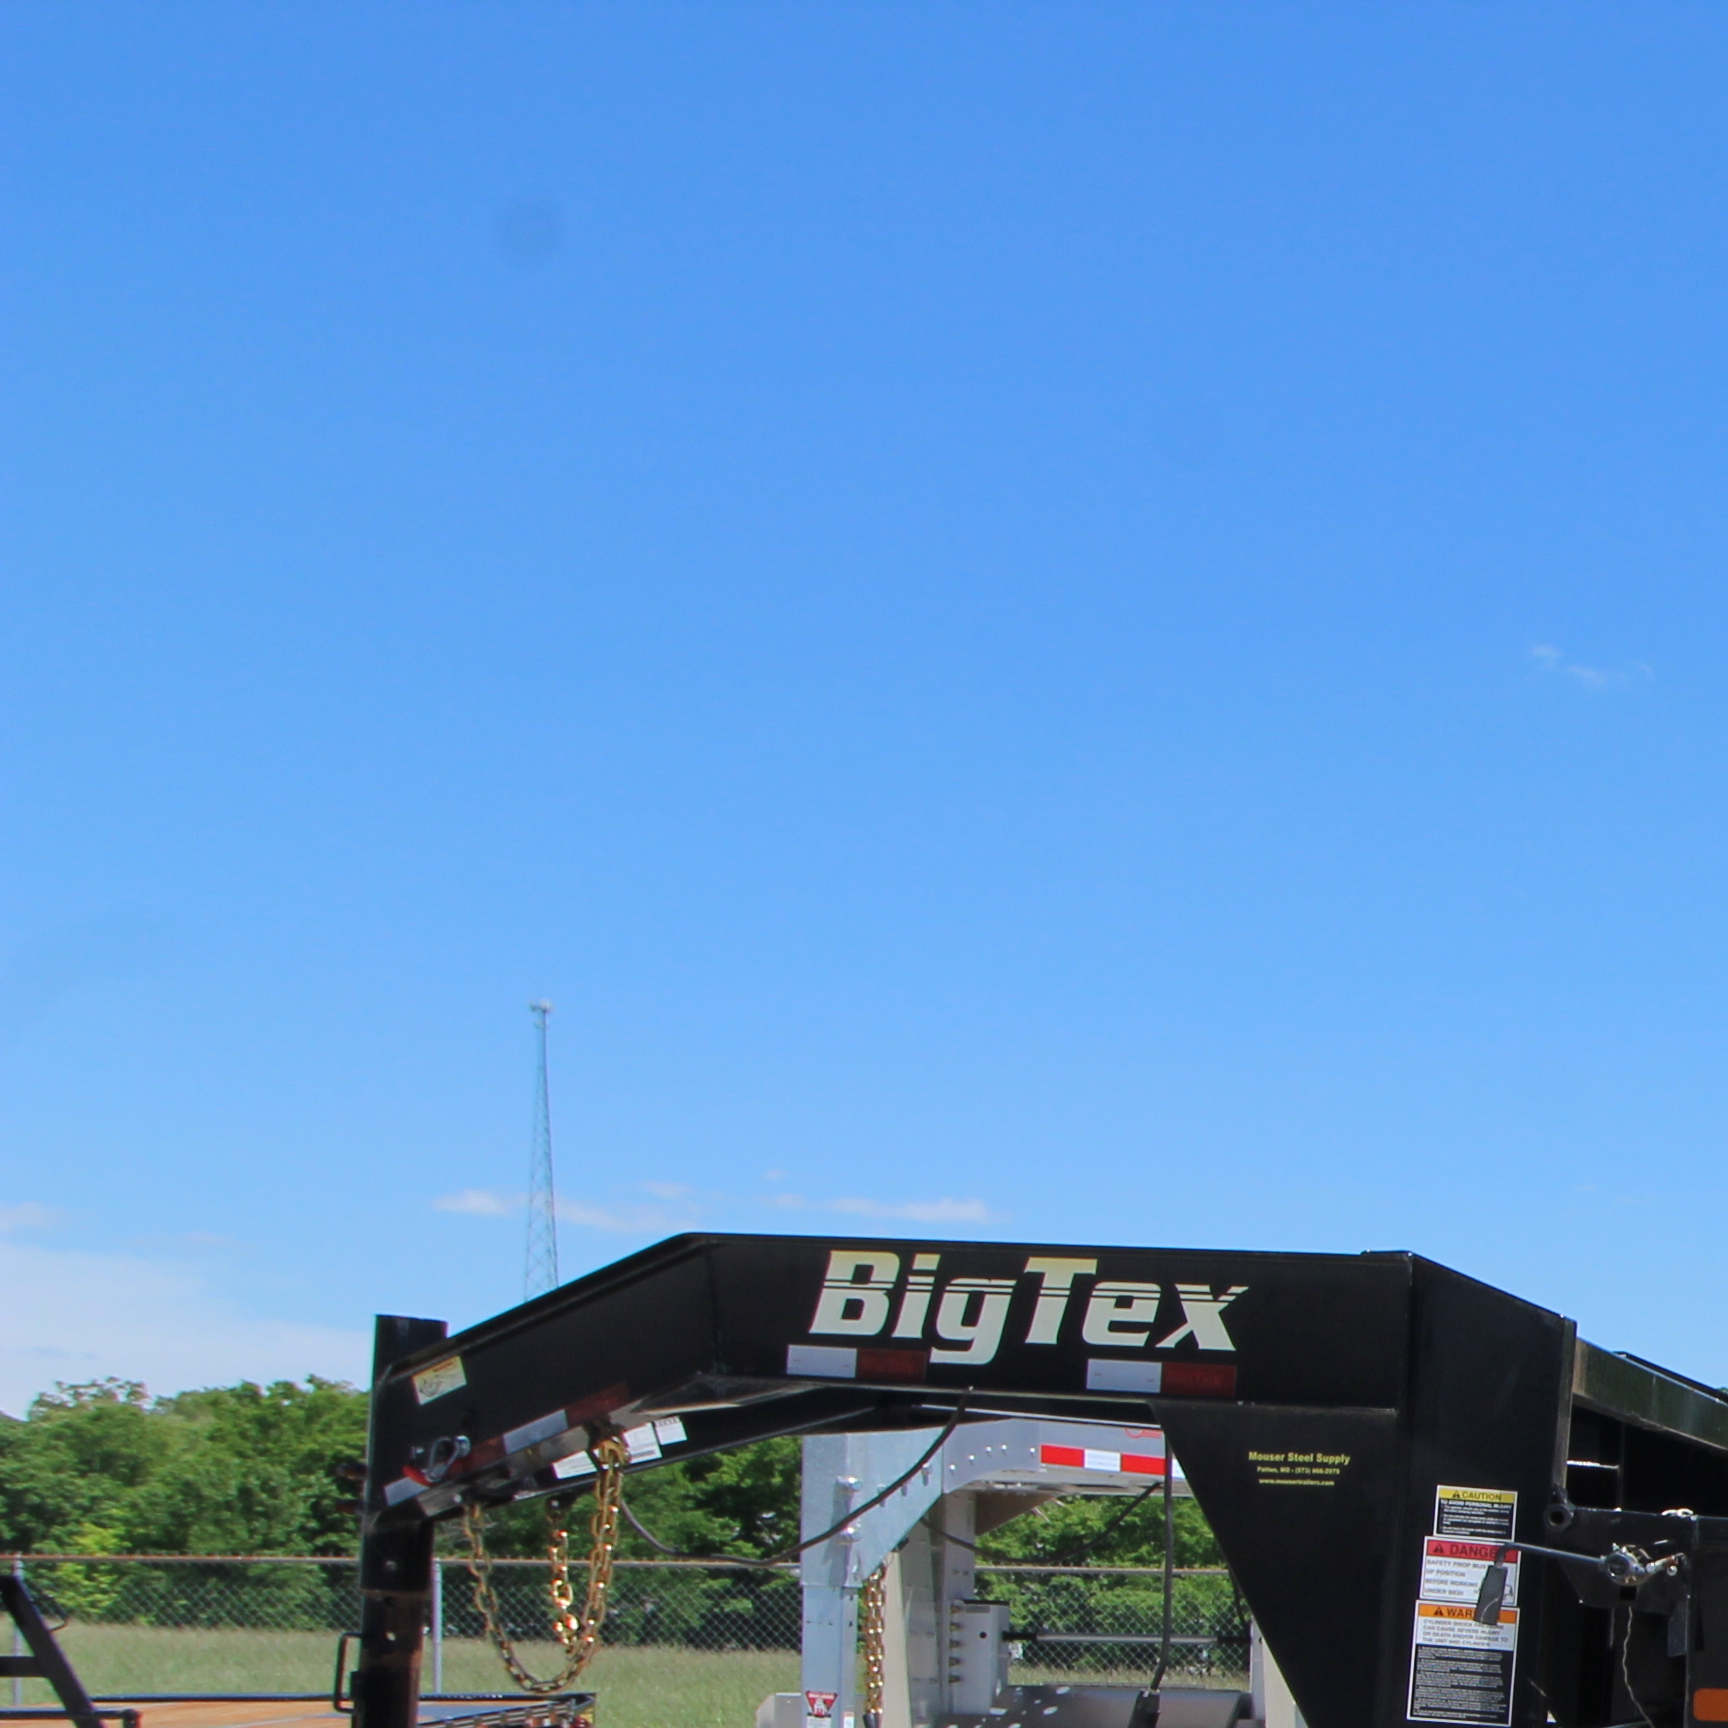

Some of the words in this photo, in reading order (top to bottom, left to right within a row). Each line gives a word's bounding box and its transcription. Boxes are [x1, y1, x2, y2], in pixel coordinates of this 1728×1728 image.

[1248, 1451, 1285, 1461] Mouser
[1287, 1452, 1314, 1462] Steel
[1316, 1453, 1351, 1466] Supply
[1462, 1491, 1502, 1501] CAUTION
[1450, 1544, 1504, 1560] DANGE
